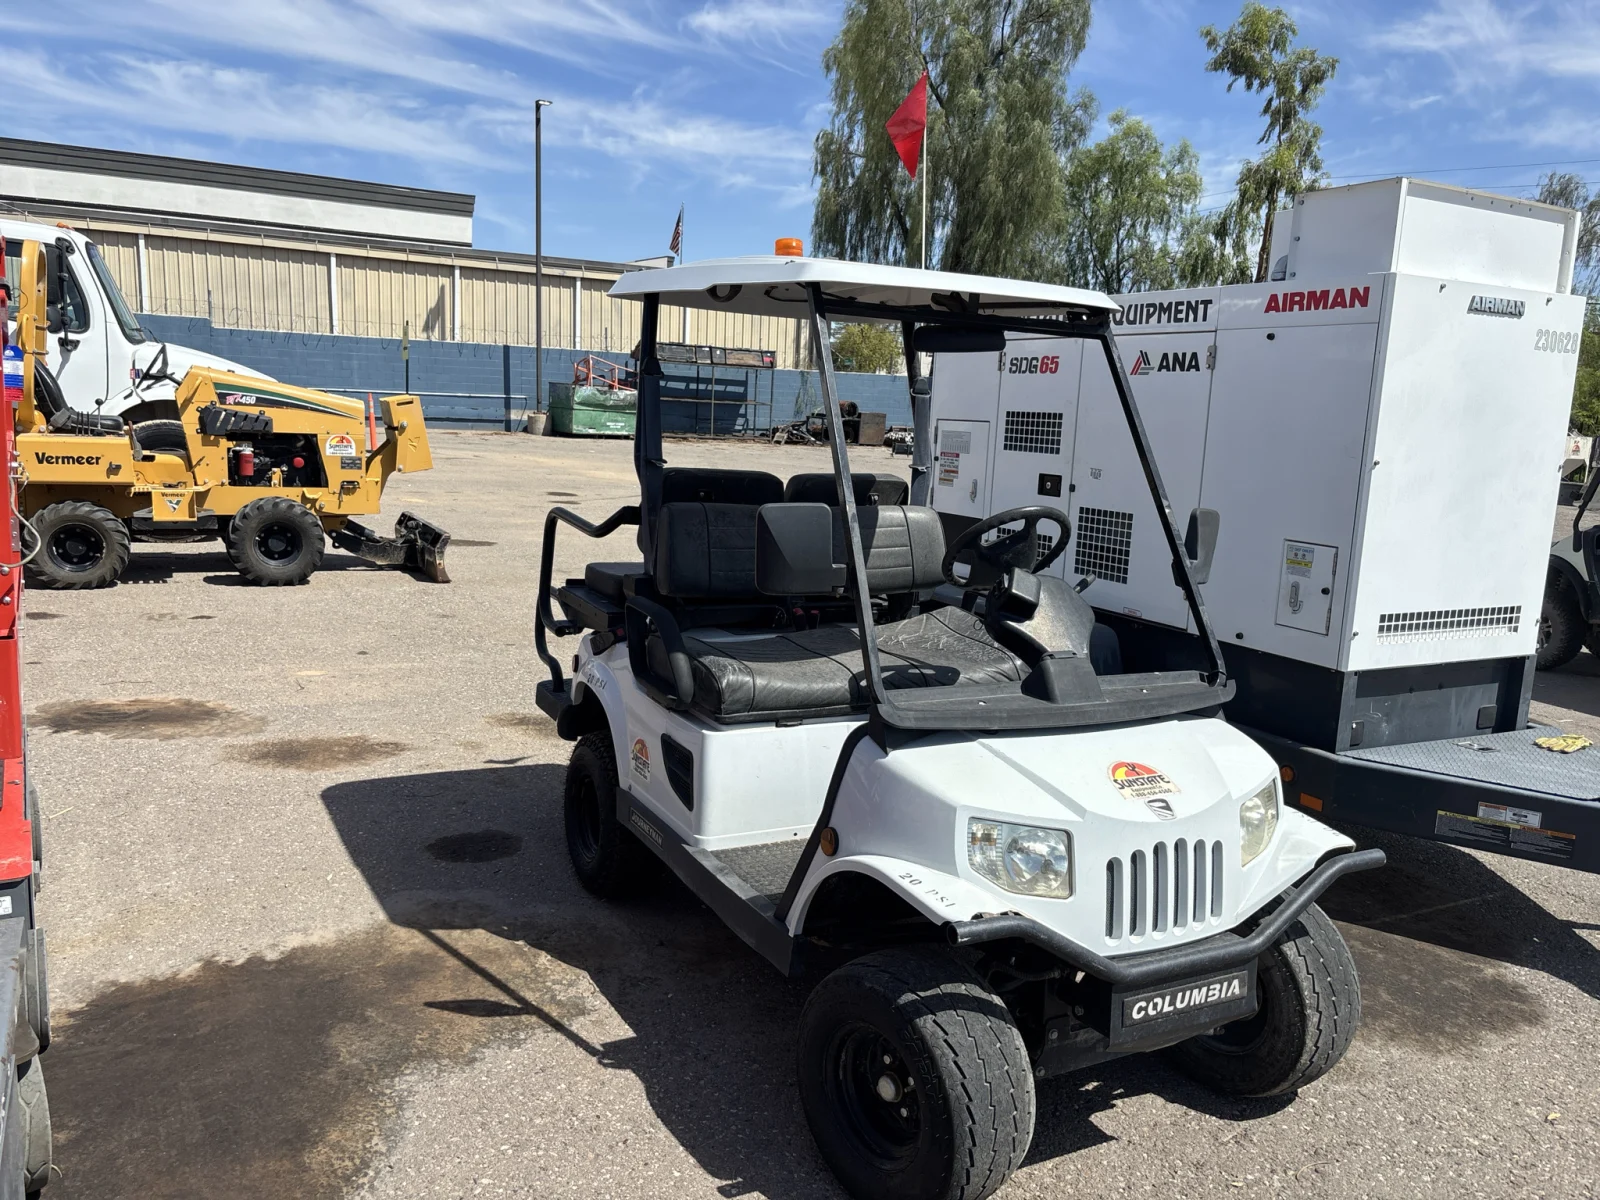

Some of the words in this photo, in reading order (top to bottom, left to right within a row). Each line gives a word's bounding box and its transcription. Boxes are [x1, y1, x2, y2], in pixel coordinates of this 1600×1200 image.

[1264, 286, 1371, 313] AIRMAN
[1471, 295, 1525, 316] AIRMAN
[1110, 299, 1213, 326] QUIPMENT
[1534, 329, 1579, 354] 230628
[1009, 355, 1060, 374] SDG65
[1156, 351, 1200, 372] ANA
[35, 452, 102, 466] Vermeer
[1113, 775, 1171, 790] SUNSTATE
[898, 872, 922, 886] 20
[1132, 979, 1240, 1020] COLUMBIA
